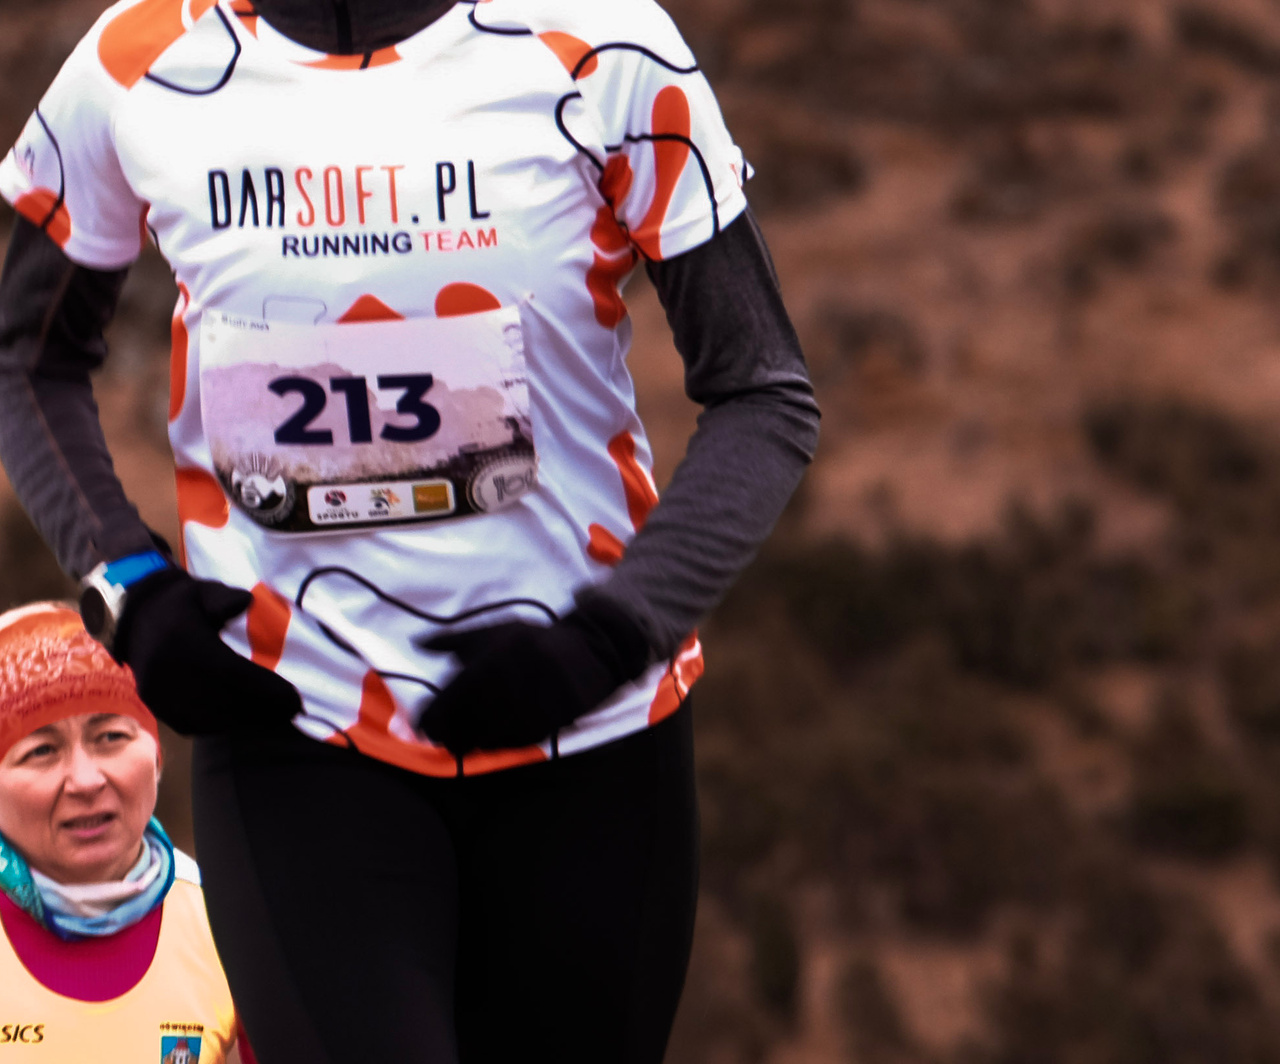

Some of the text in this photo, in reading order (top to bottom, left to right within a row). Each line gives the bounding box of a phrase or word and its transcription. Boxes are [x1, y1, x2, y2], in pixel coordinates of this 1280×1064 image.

[282, 227, 498, 258] RUNNING TEAM
[267, 373, 441, 446] 213
